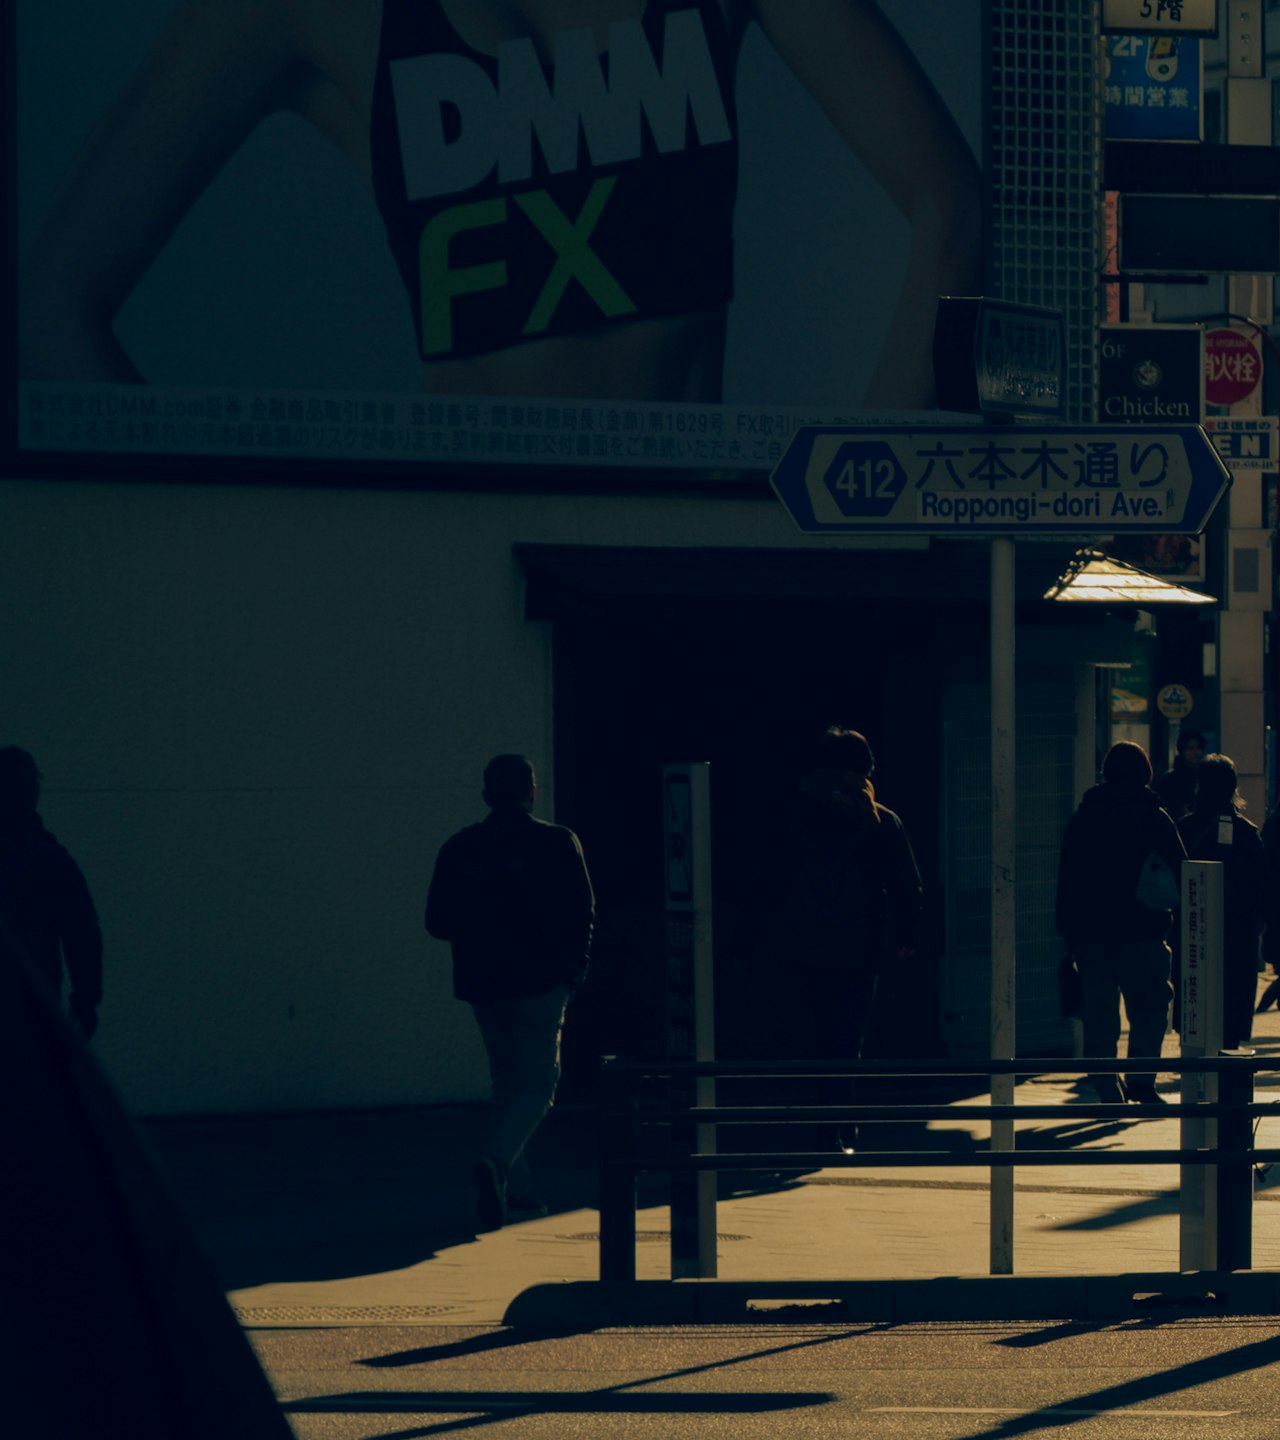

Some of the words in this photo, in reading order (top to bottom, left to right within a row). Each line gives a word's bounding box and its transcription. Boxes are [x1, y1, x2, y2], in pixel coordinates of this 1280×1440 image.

[389, 8, 732, 201] DMM
[418, 176, 639, 358] FX
[1102, 338, 1126, 359] 6F
[26, 391, 239, 419] 株式会社DMM.com証券
[1105, 396, 1190, 416] Chicken
[835, 458, 896, 500] 412
[914, 441, 1170, 489] 六本木通り
[921, 492, 1101, 522] Roppongi-dori
[1111, 493, 1163, 517] Ave.
